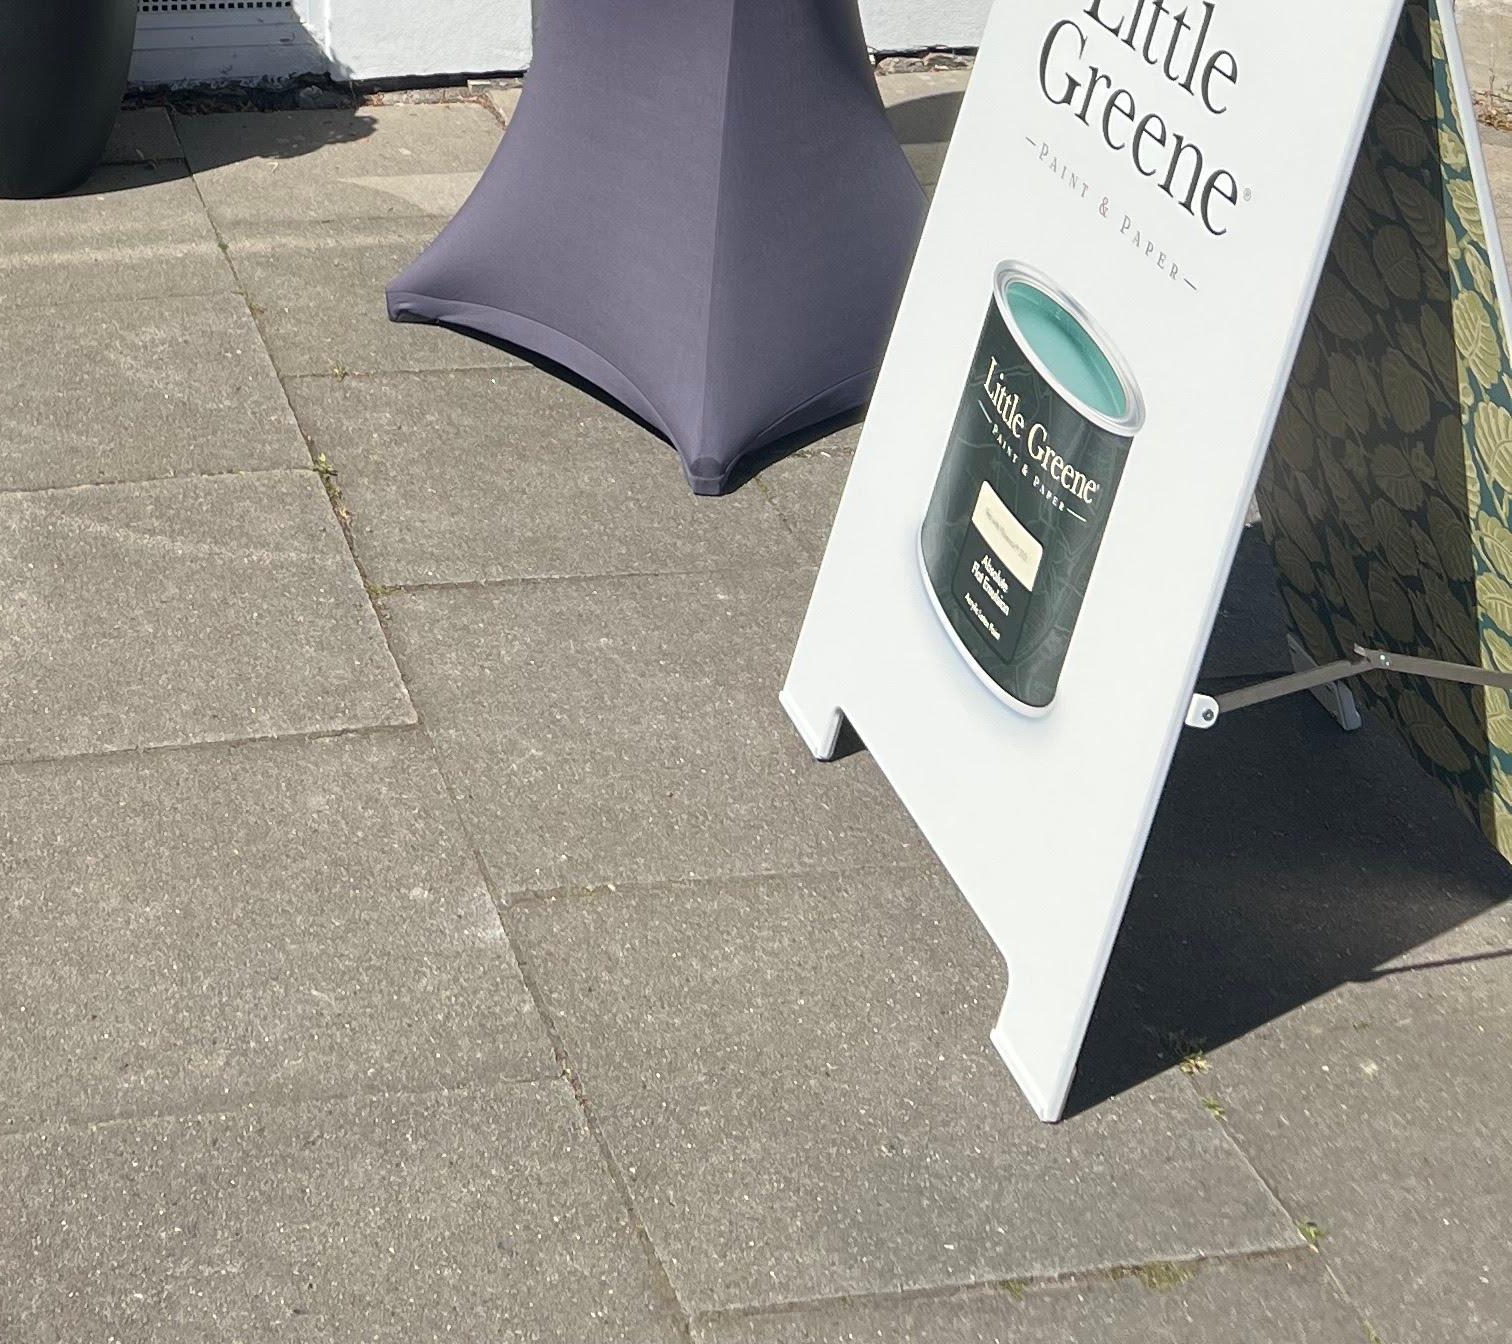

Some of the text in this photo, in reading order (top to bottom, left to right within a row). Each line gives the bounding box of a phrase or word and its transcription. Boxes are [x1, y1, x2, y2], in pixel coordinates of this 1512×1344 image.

[1039, 143, 1179, 280] PAINT & PAPER
[983, 355, 1025, 438] Little
